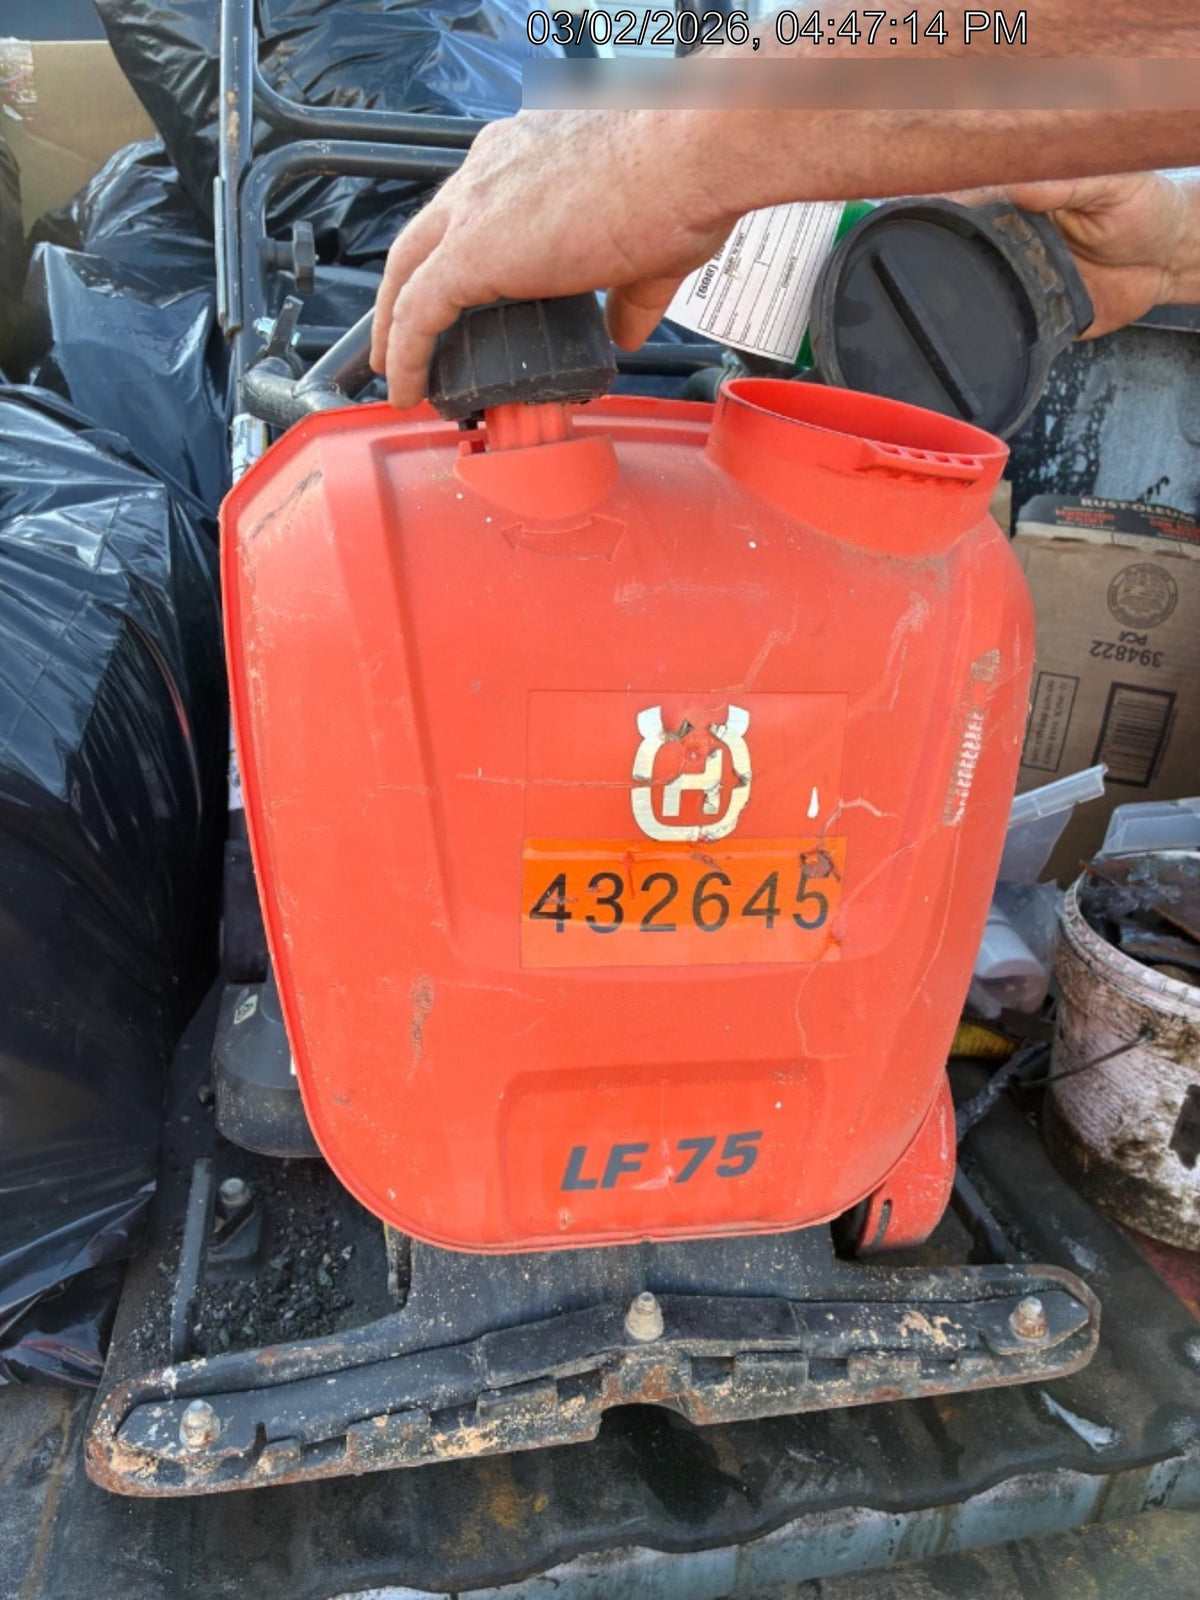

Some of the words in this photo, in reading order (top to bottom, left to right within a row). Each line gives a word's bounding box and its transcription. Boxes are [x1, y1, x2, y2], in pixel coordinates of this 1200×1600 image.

[1089, 640, 1165, 668] 394822
[529, 870, 828, 934] 432645
[560, 1142, 650, 1192] LF
[674, 1130, 763, 1184] 75
